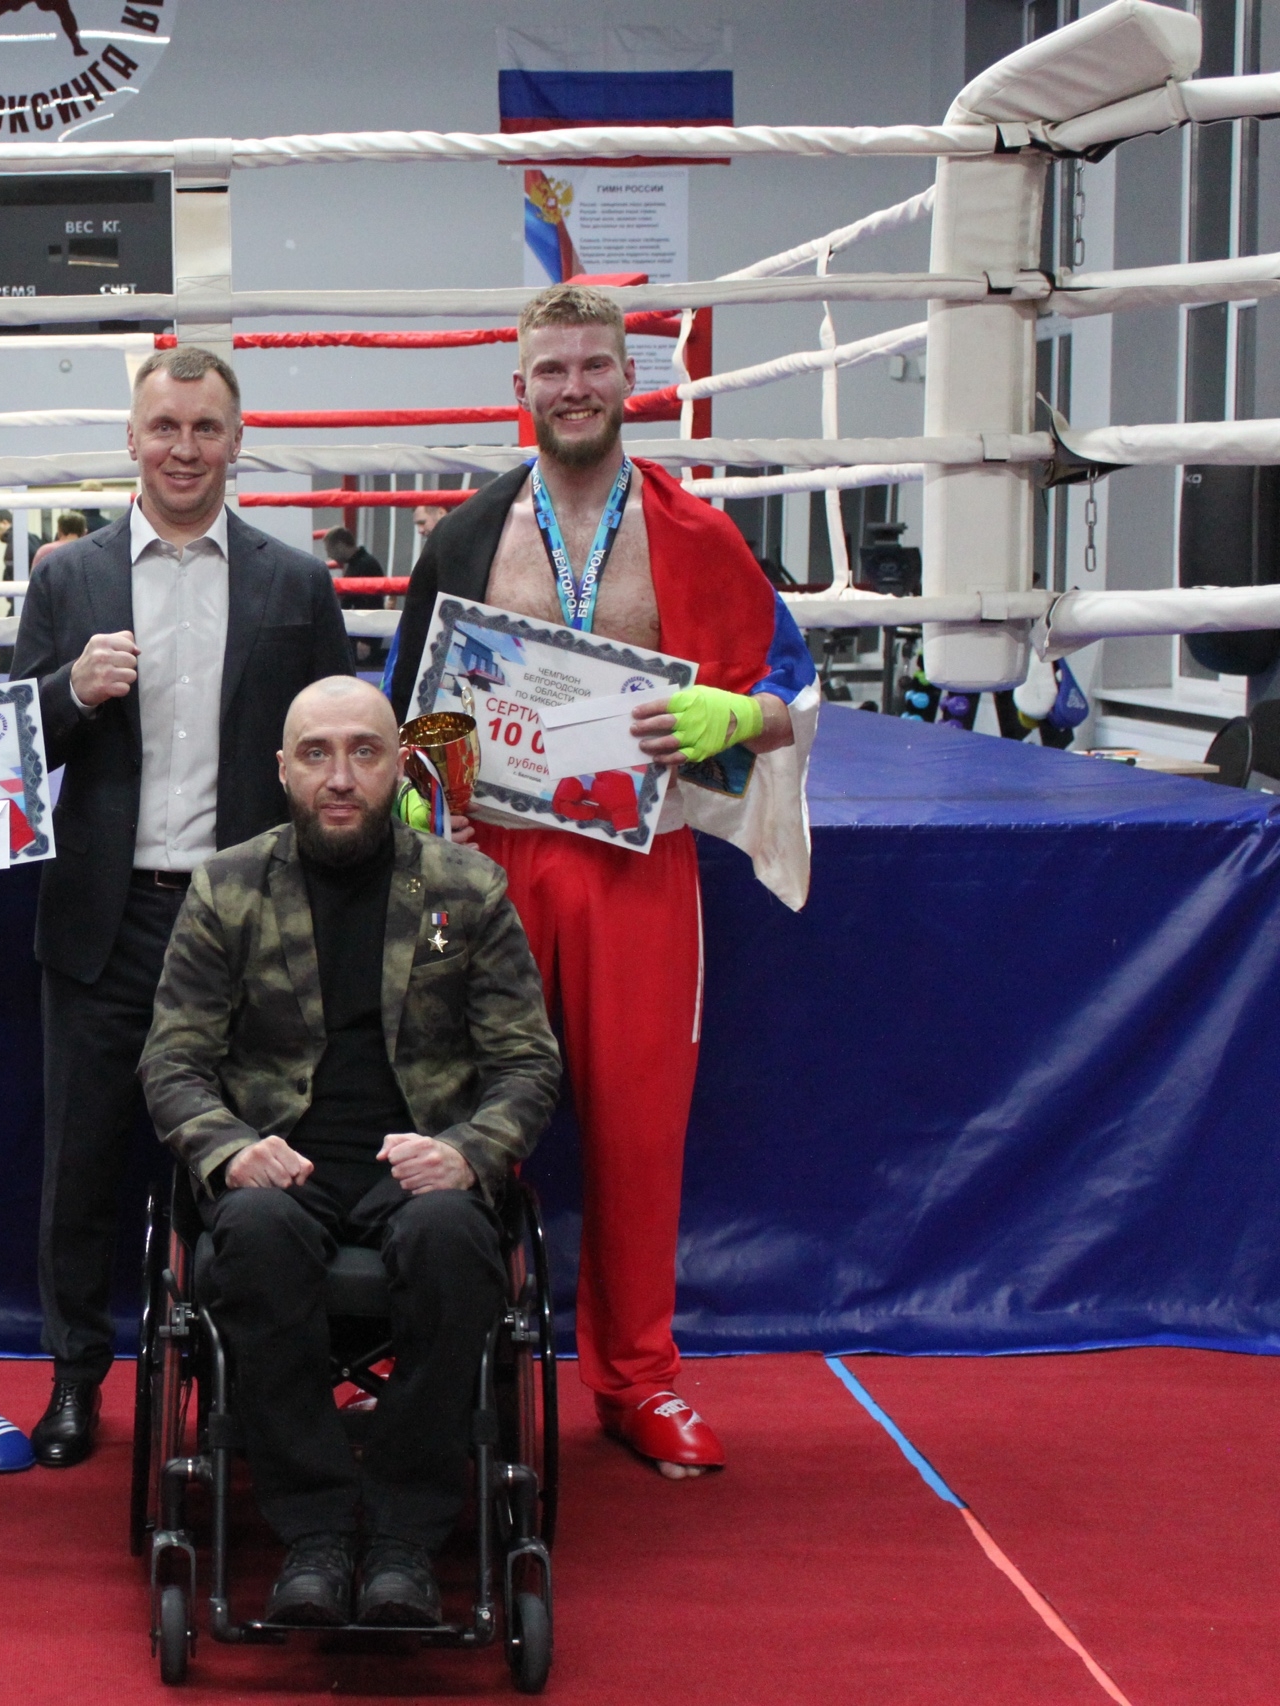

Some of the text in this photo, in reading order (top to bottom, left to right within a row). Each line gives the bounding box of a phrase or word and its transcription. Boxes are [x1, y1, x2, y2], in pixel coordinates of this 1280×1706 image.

[597, 184, 664, 193] ГИМН РОССИИ
[65, 220, 122, 234] ВЕС КГ.
[577, 548, 606, 619] БЕЛГОРОД
[523, 672, 591, 698] БЕЛГОРОДСКОЙ
[538, 667, 581, 685] ЧЕМПИОН
[515, 690, 528, 700] ПО
[535, 686, 575, 703] ОБЛАСТИ
[486, 697, 539, 724] СЕРТИ
[488, 717, 522, 747] 10
